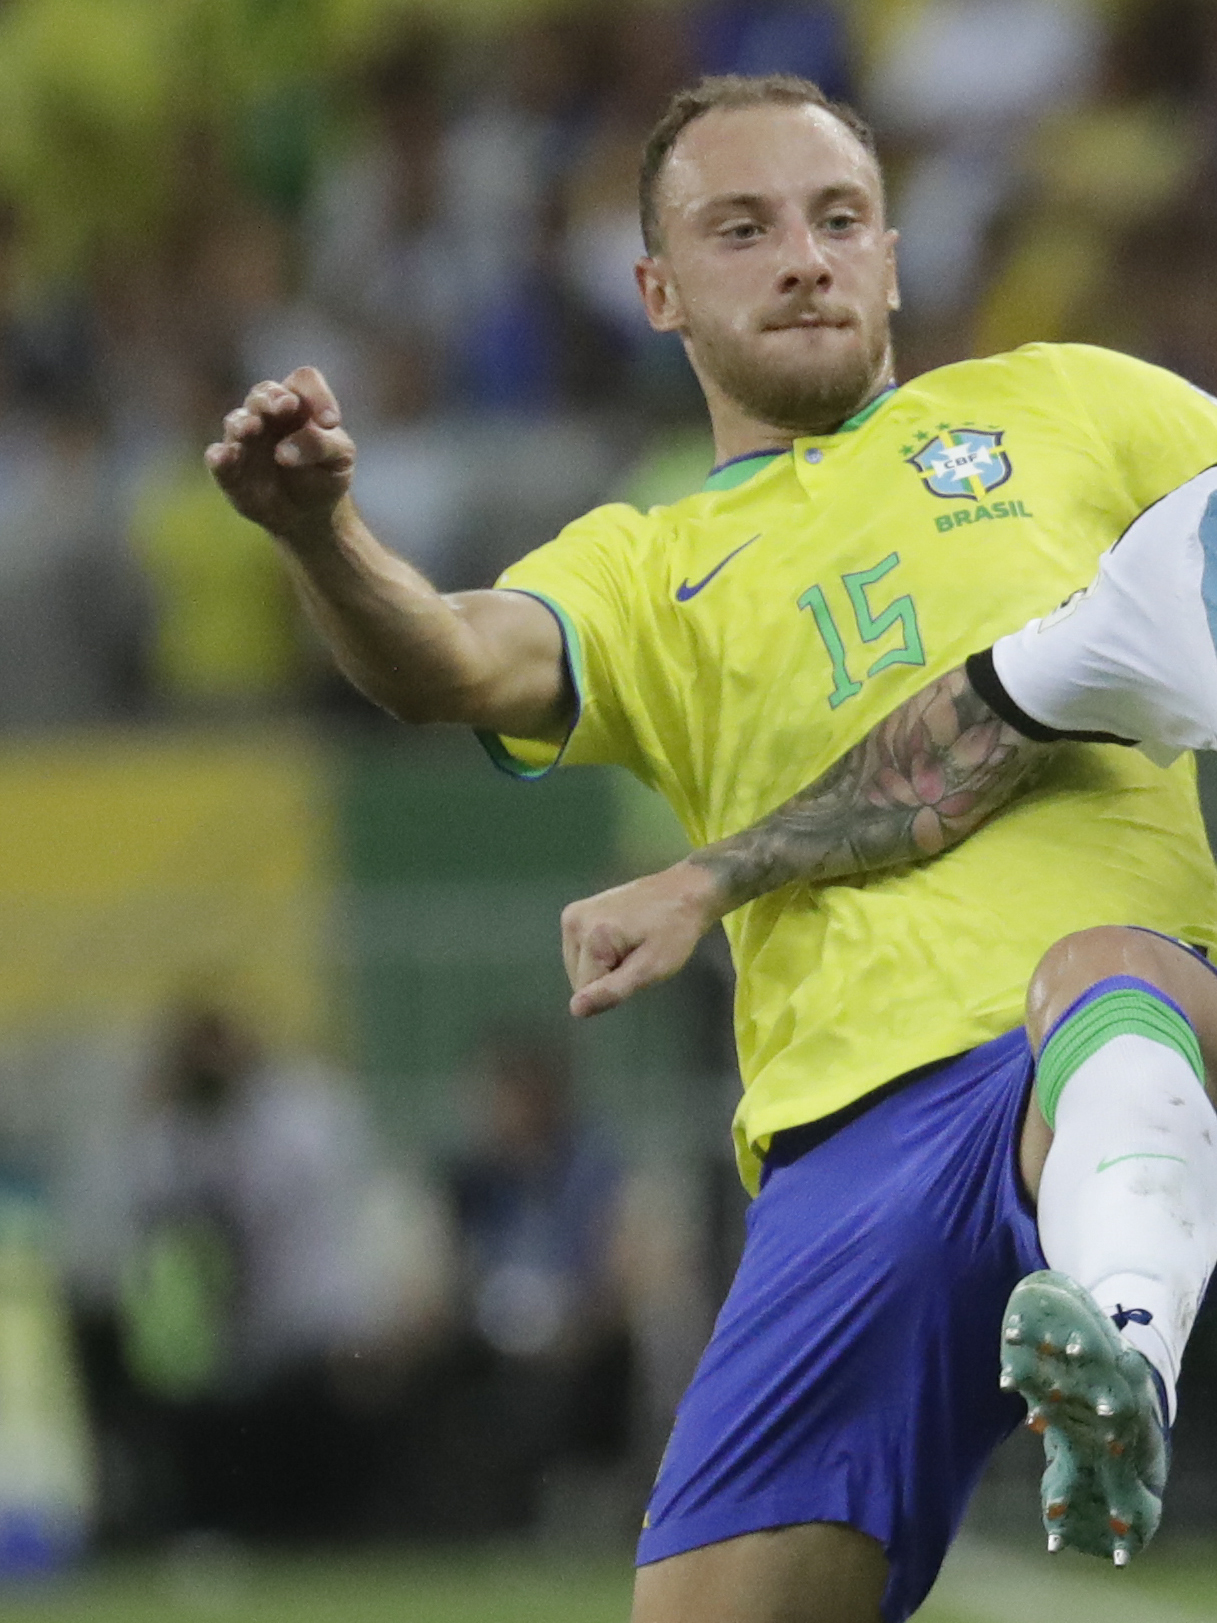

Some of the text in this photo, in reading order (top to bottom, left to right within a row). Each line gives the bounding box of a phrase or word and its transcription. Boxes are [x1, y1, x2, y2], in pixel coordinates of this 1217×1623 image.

[944, 452, 977, 469] CBF
[935, 500, 1032, 533] BRASIL
[797, 552, 925, 710] 15
